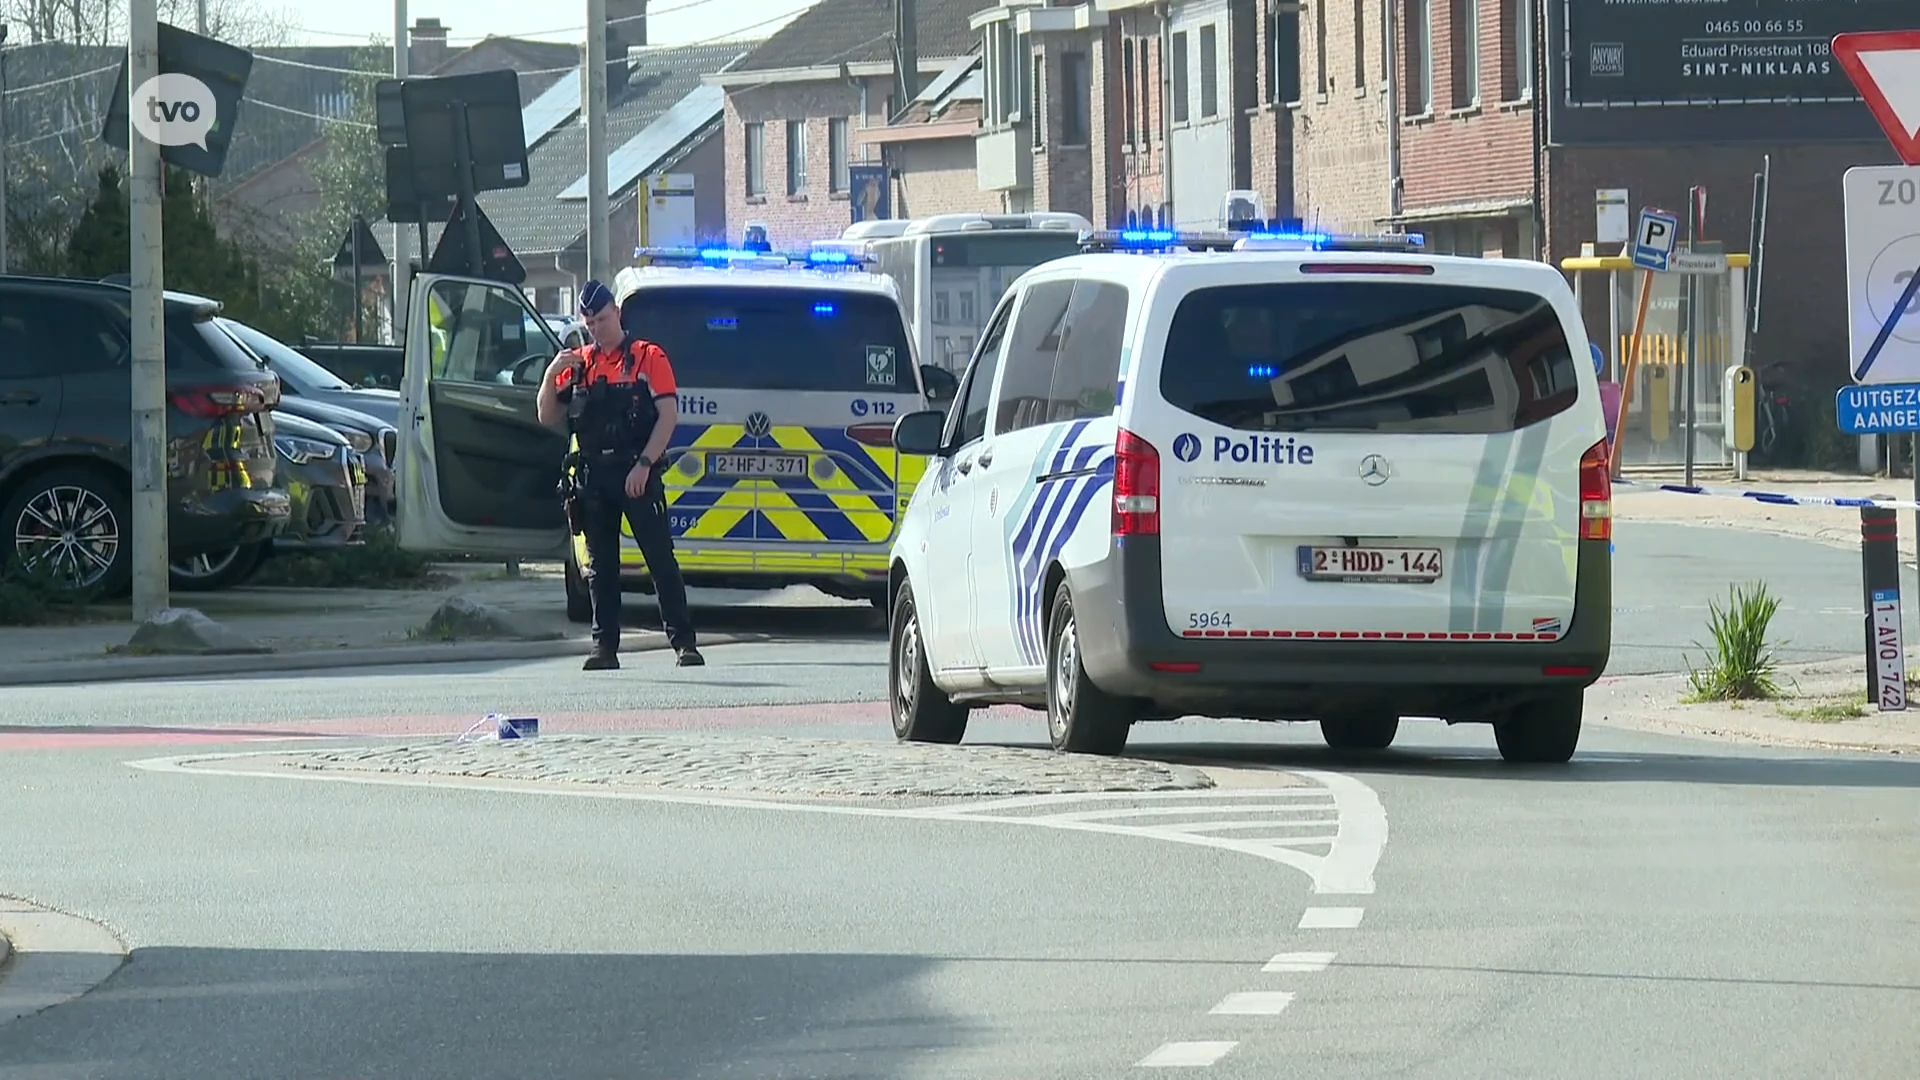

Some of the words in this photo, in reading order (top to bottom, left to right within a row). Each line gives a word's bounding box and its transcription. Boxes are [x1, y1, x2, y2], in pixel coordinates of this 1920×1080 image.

[1705, 21, 1740, 33] 0465
[1744, 20, 1761, 33] 00
[1765, 20, 1783, 32] 66
[1787, 19, 1804, 32] 55
[1592, 47, 1622, 64] ANYWAY
[1681, 44, 1727, 57] Eduard
[1730, 43, 1802, 57] Prissestraat
[1806, 43, 1829, 55] 108
[1592, 64, 1622, 72] DOORS
[1682, 61, 1831, 76] SINT-NIKLAAS
[1878, 178, 1920, 205] ZO
[1645, 221, 1665, 245] P
[868, 373, 894, 383] AED
[675, 395, 718, 415] litie
[1850, 389, 1920, 408] UITGEZ
[872, 402, 895, 415] 112
[1854, 410, 1920, 429] AANGE
[1214, 435, 1314, 464] Politie
[670, 516, 699, 529] 964
[1189, 611, 1233, 629] 5964
